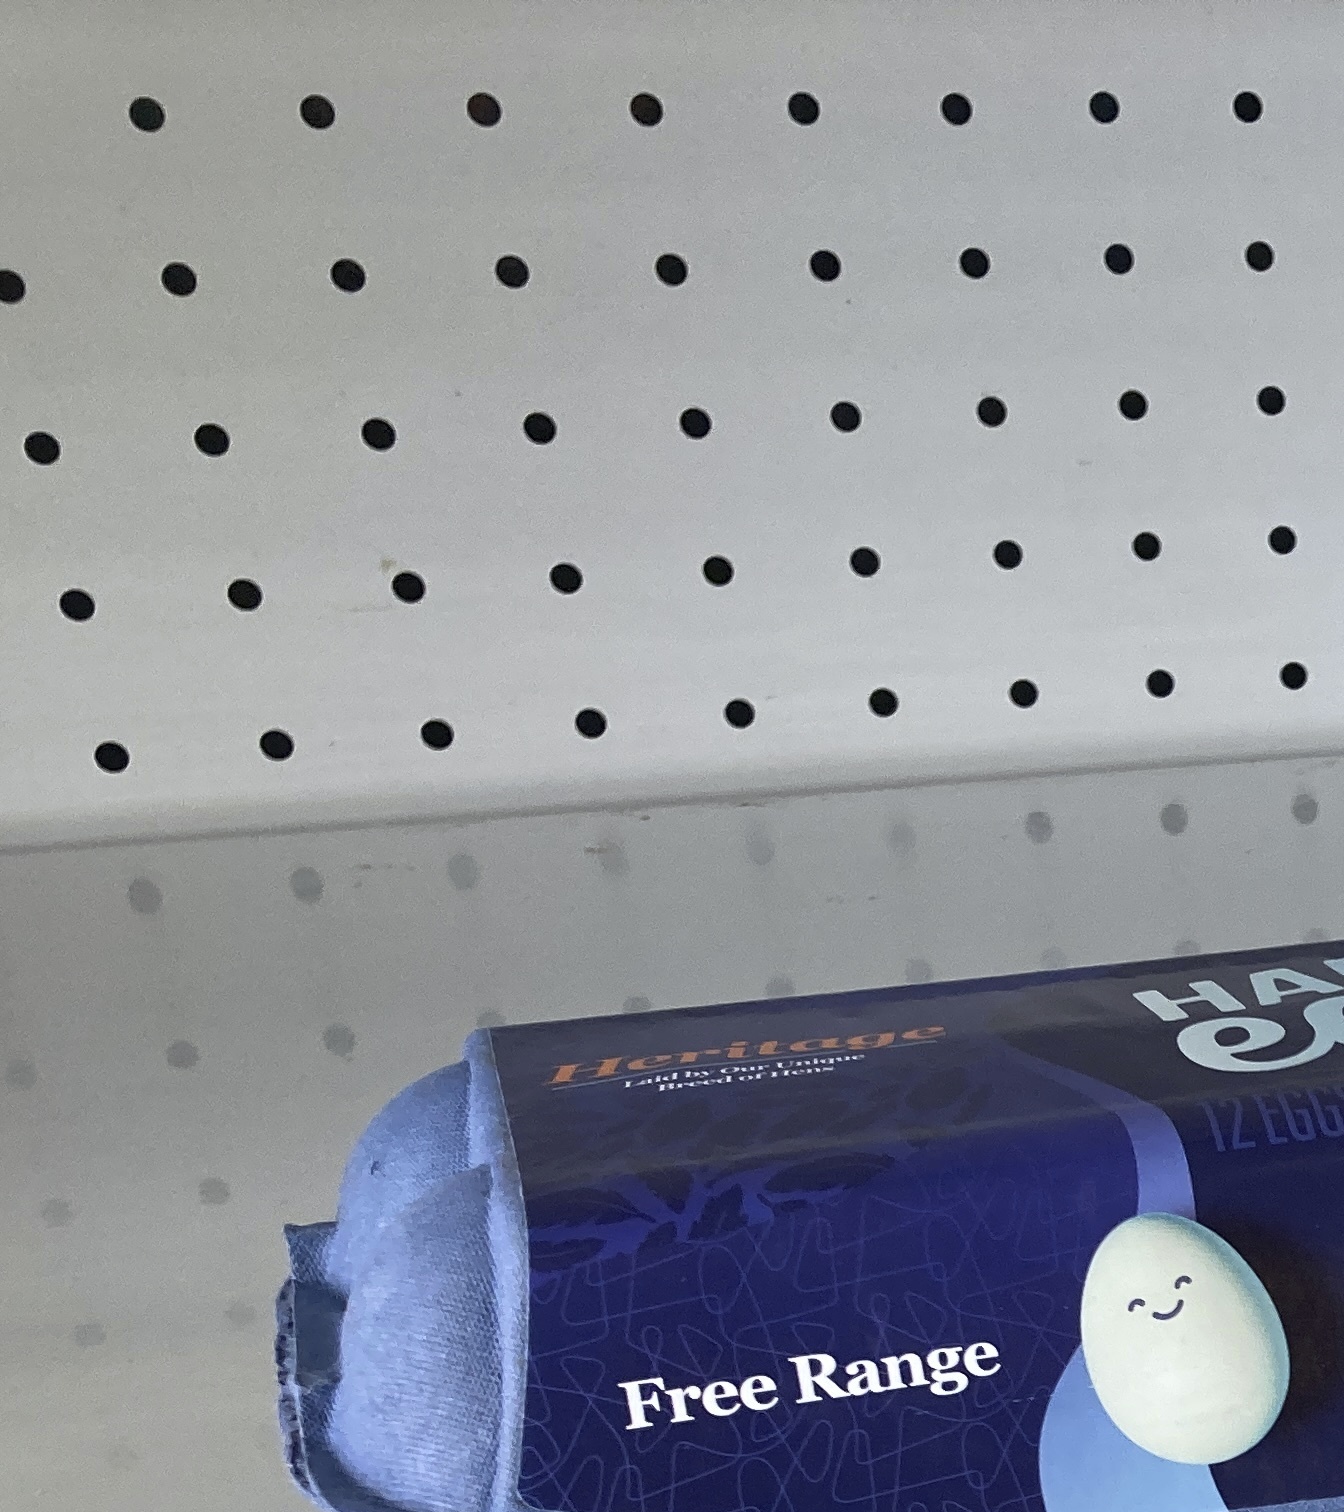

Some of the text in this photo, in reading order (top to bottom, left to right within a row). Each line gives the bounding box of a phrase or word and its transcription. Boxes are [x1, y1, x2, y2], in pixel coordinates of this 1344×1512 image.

[544, 1026, 946, 1085] Heritage
[617, 1340, 1004, 1431] Free Range
